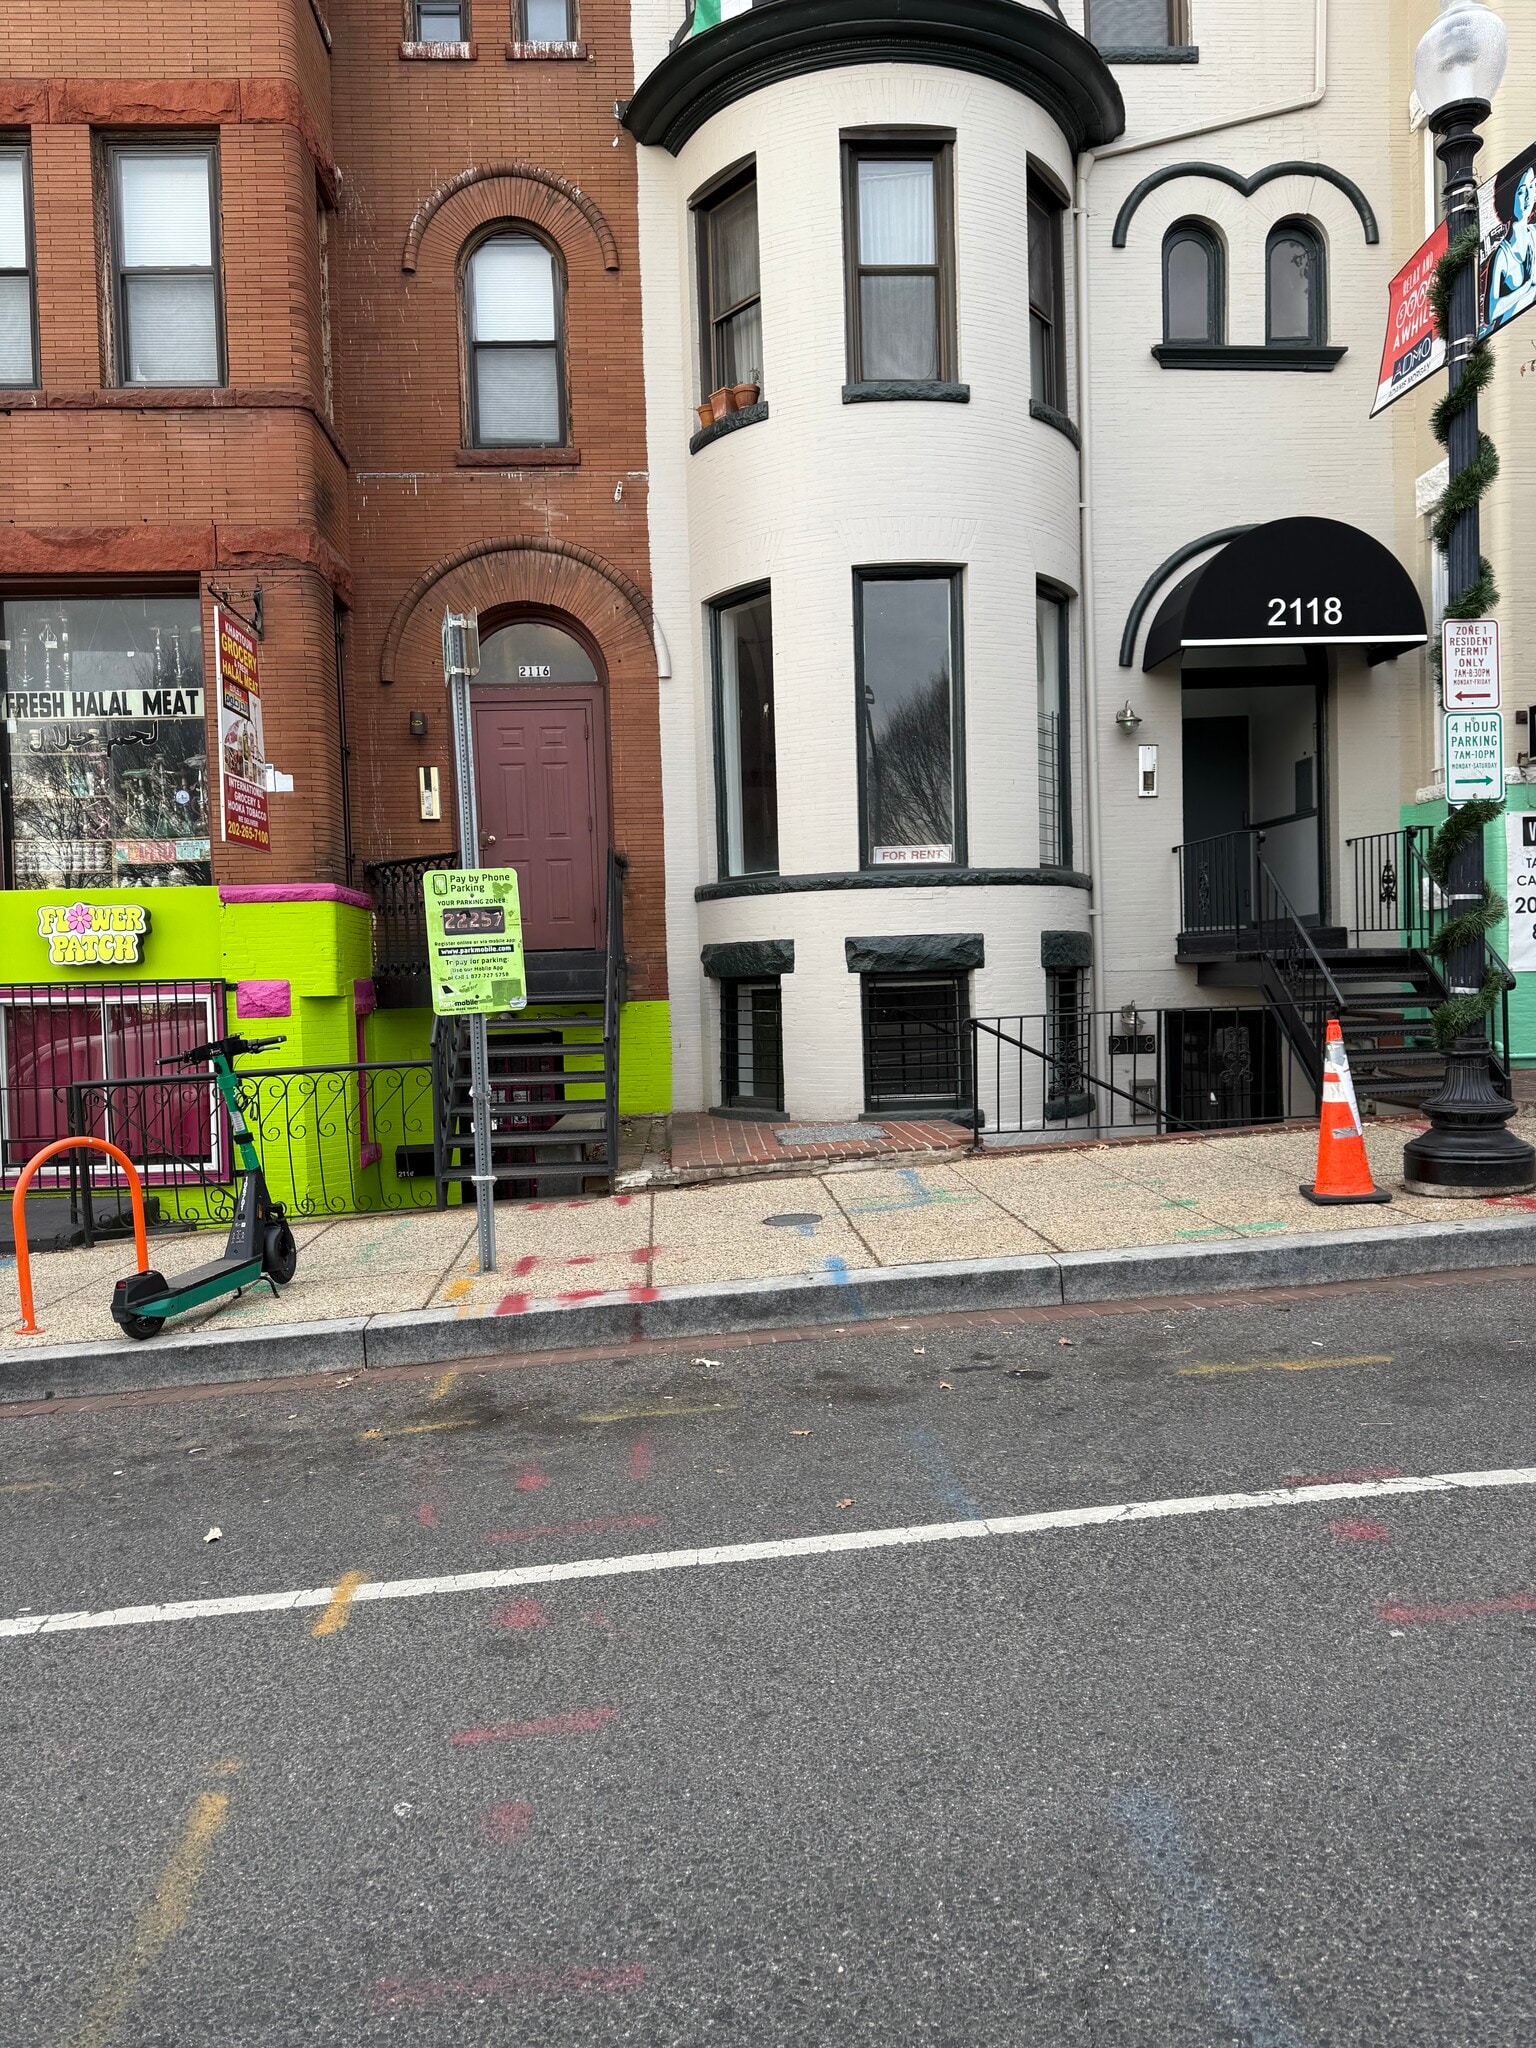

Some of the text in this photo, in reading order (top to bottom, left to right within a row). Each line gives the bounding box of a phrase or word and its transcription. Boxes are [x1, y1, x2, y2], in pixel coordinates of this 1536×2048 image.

[1403, 251, 1434, 297] RELAX AND
[1393, 336, 1431, 382] ADMO
[1267, 597, 1343, 626] 2118
[1456, 626, 1487, 635] ZONE 1
[1449, 637, 1493, 646] RESIDENT
[221, 632, 257, 674] GROCERY
[1454, 647, 1488, 656] PERMIT
[1458, 658, 1484, 667] ONLY
[222, 659, 258, 695] HALAL MEAT
[519, 666, 549, 677] 2116
[1454, 669, 1491, 678] 7AM-8:30PM
[6, 689, 199, 719] FRESH HALAL MEAT
[1451, 721, 1497, 733] 4 HOUR
[1451, 735, 1498, 747] PARKING
[1454, 750, 1495, 759] 7AM-10PM
[1451, 762, 1498, 770] MONDAY-SATURDAY
[228, 776, 265, 800] INTERNATIONAL
[234, 791, 257, 807] GROCERY
[246, 805, 267, 822] TOBACCO
[227, 820, 269, 844] 202-265-7100
[882, 849, 944, 861] FOR RENT
[449, 873, 510, 884] Pay by Phone
[450, 884, 485, 893] Parking
[444, 910, 503, 929] 22257
[51, 934, 136, 962] PATCH
[440, 945, 512, 955] www.parkmobile.com
